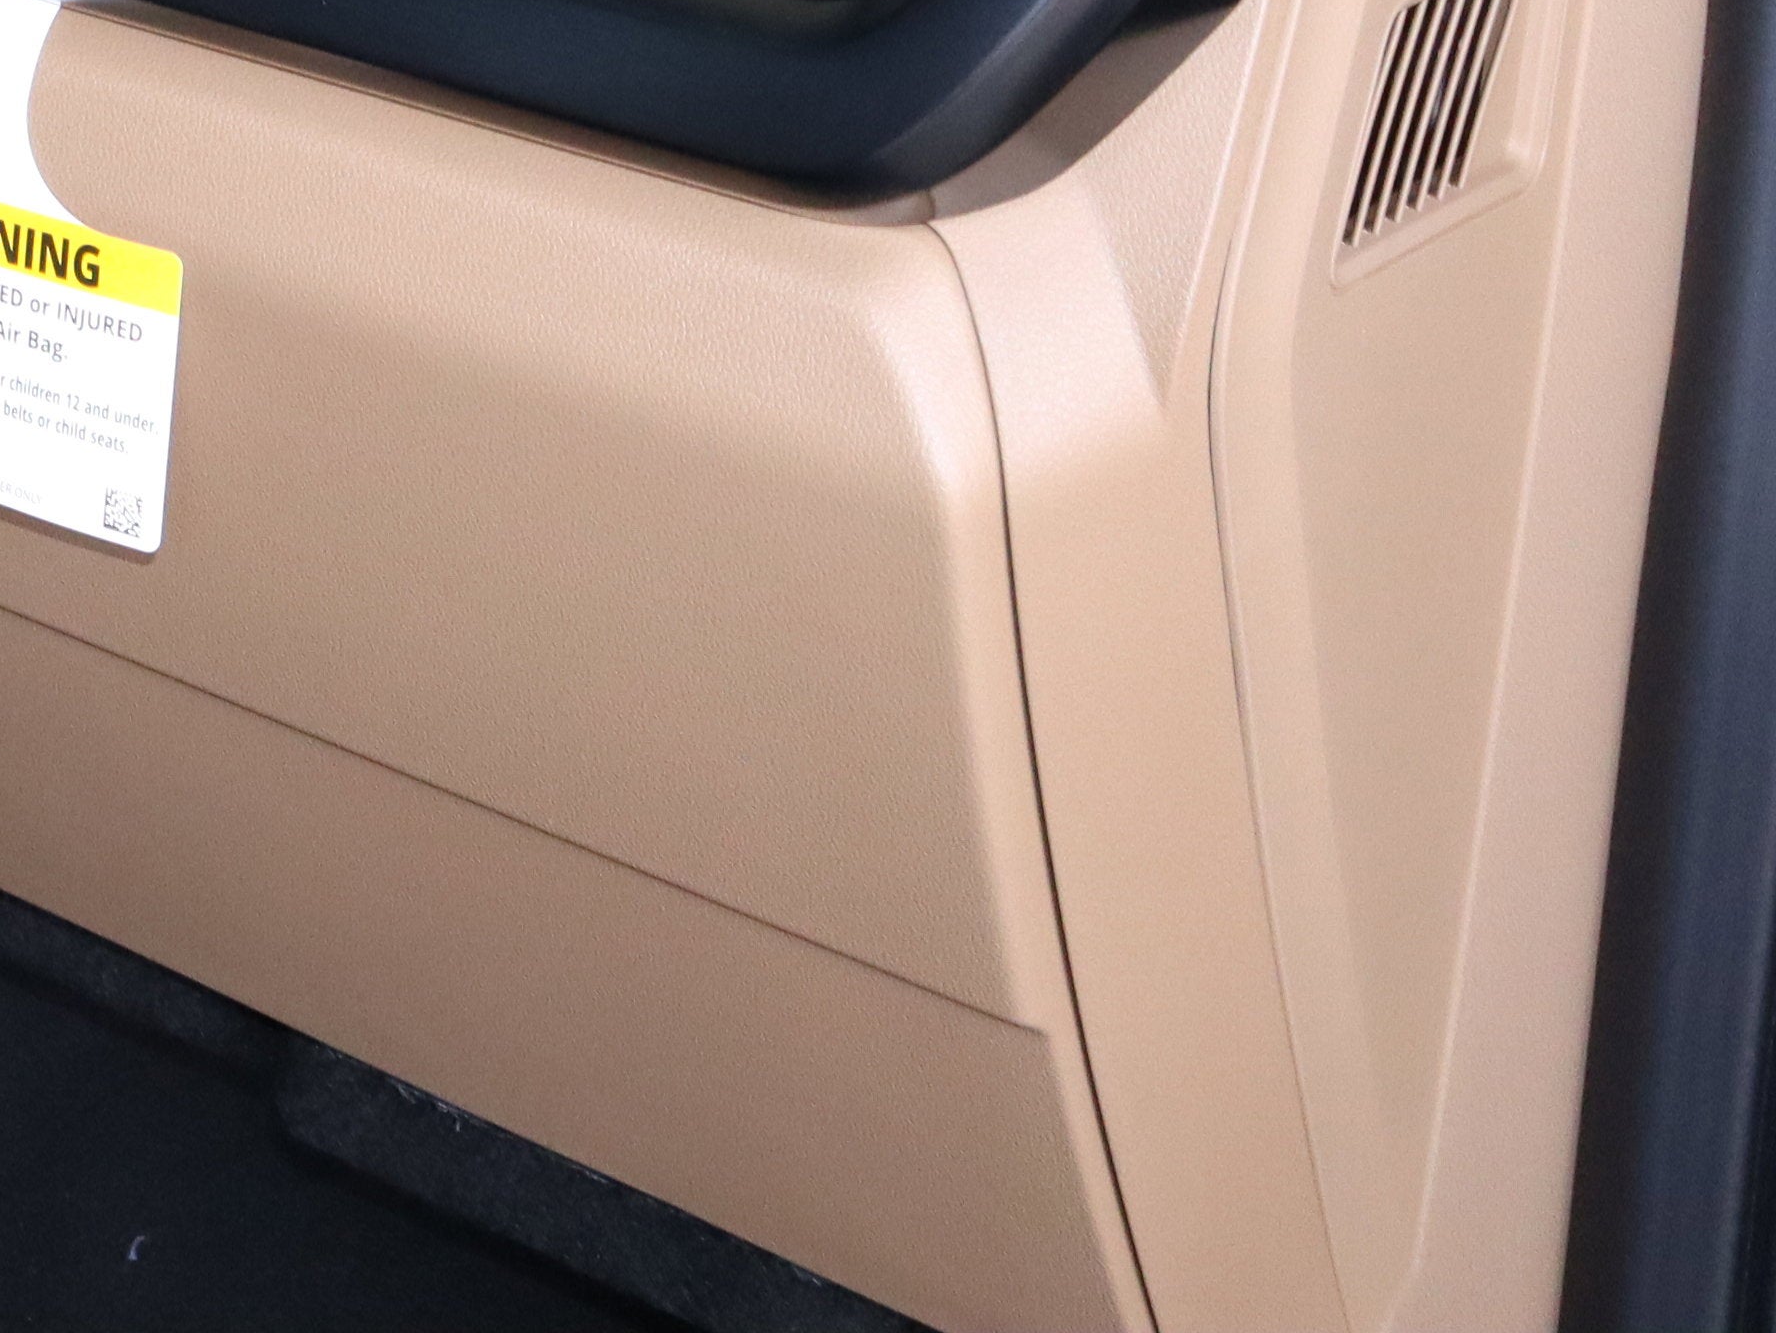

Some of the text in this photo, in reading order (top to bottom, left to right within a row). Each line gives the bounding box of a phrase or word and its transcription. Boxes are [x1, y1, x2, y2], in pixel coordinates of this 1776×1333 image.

[28, 297, 51, 315] or
[56, 301, 143, 342] INJURED
[26, 329, 68, 363] Bag.
[2, 399, 33, 424] belts
[36, 414, 51, 429] or
[54, 417, 87, 441] child
[90, 431, 129, 453] seats.
[8, 374, 61, 405] children
[65, 392, 80, 412] 12
[83, 401, 110, 420] and
[113, 410, 158, 433] under.
[14, 486, 43, 507] ONLY
